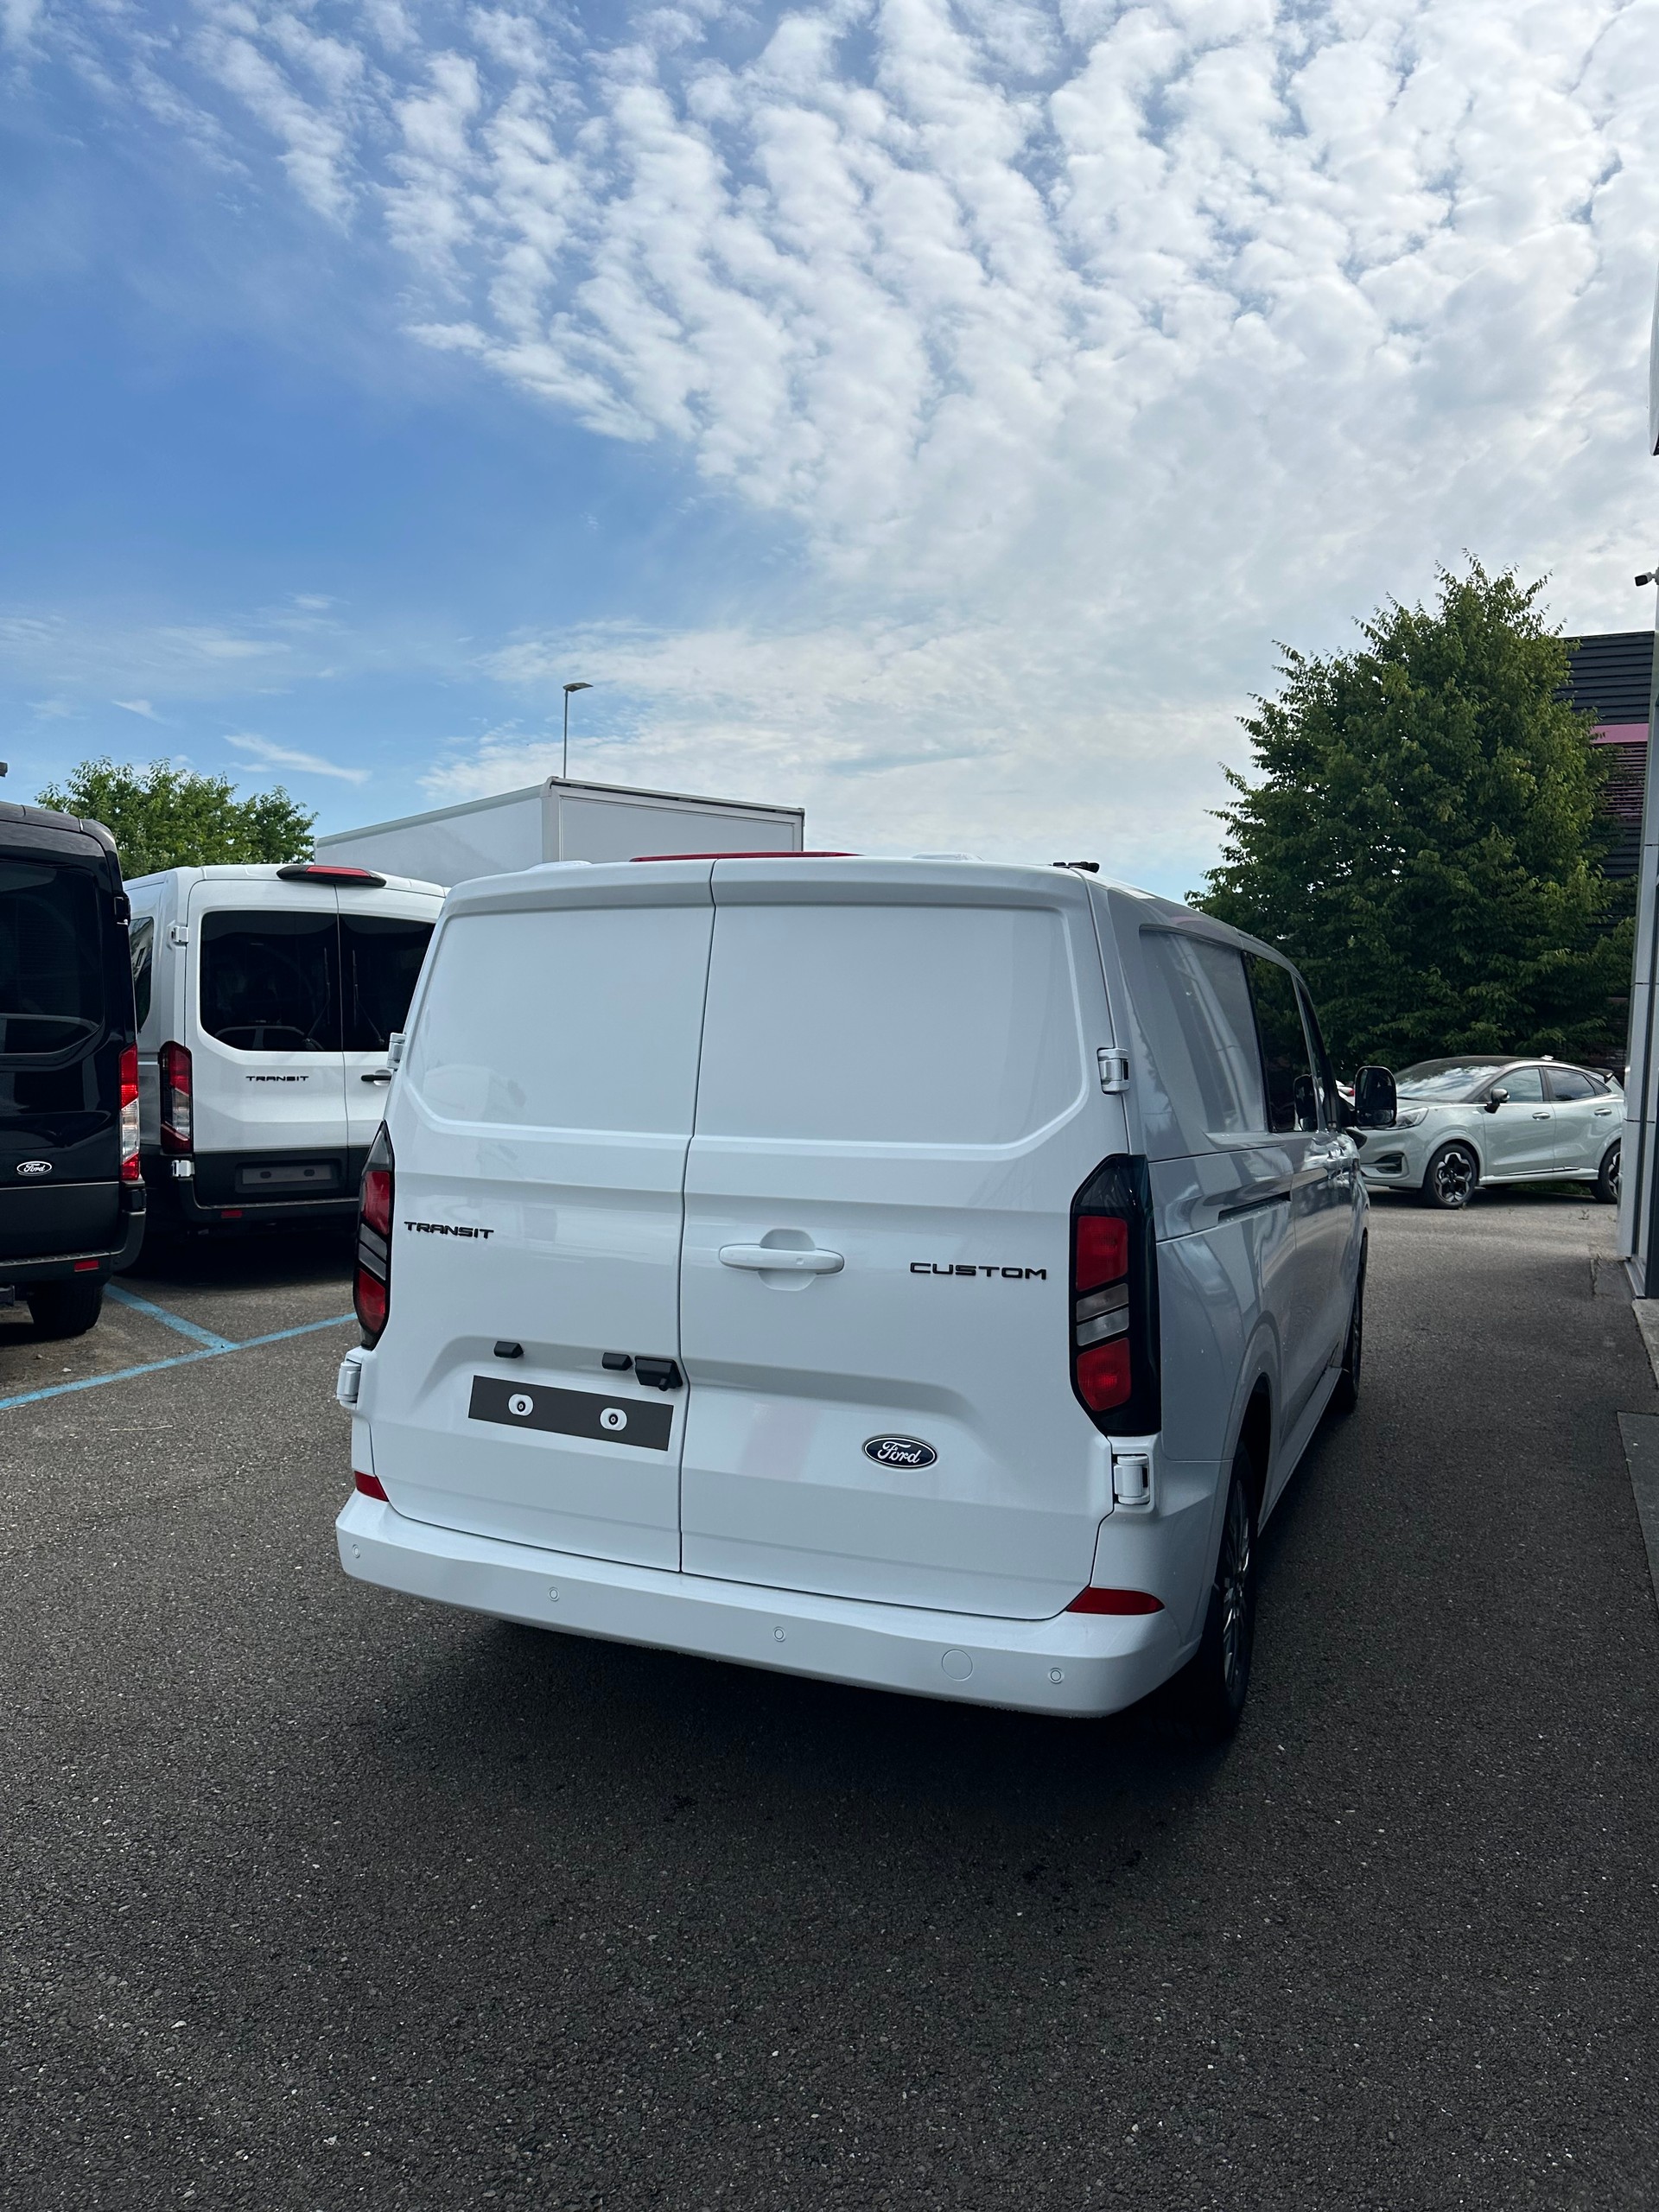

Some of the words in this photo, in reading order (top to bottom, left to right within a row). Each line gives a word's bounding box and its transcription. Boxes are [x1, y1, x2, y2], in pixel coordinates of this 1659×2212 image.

[23, 1163, 46, 1173] Ford
[404, 1221, 494, 1239] TRANSIT
[910, 1262, 1047, 1281] CUSTOM
[877, 1440, 922, 1464] Ford
